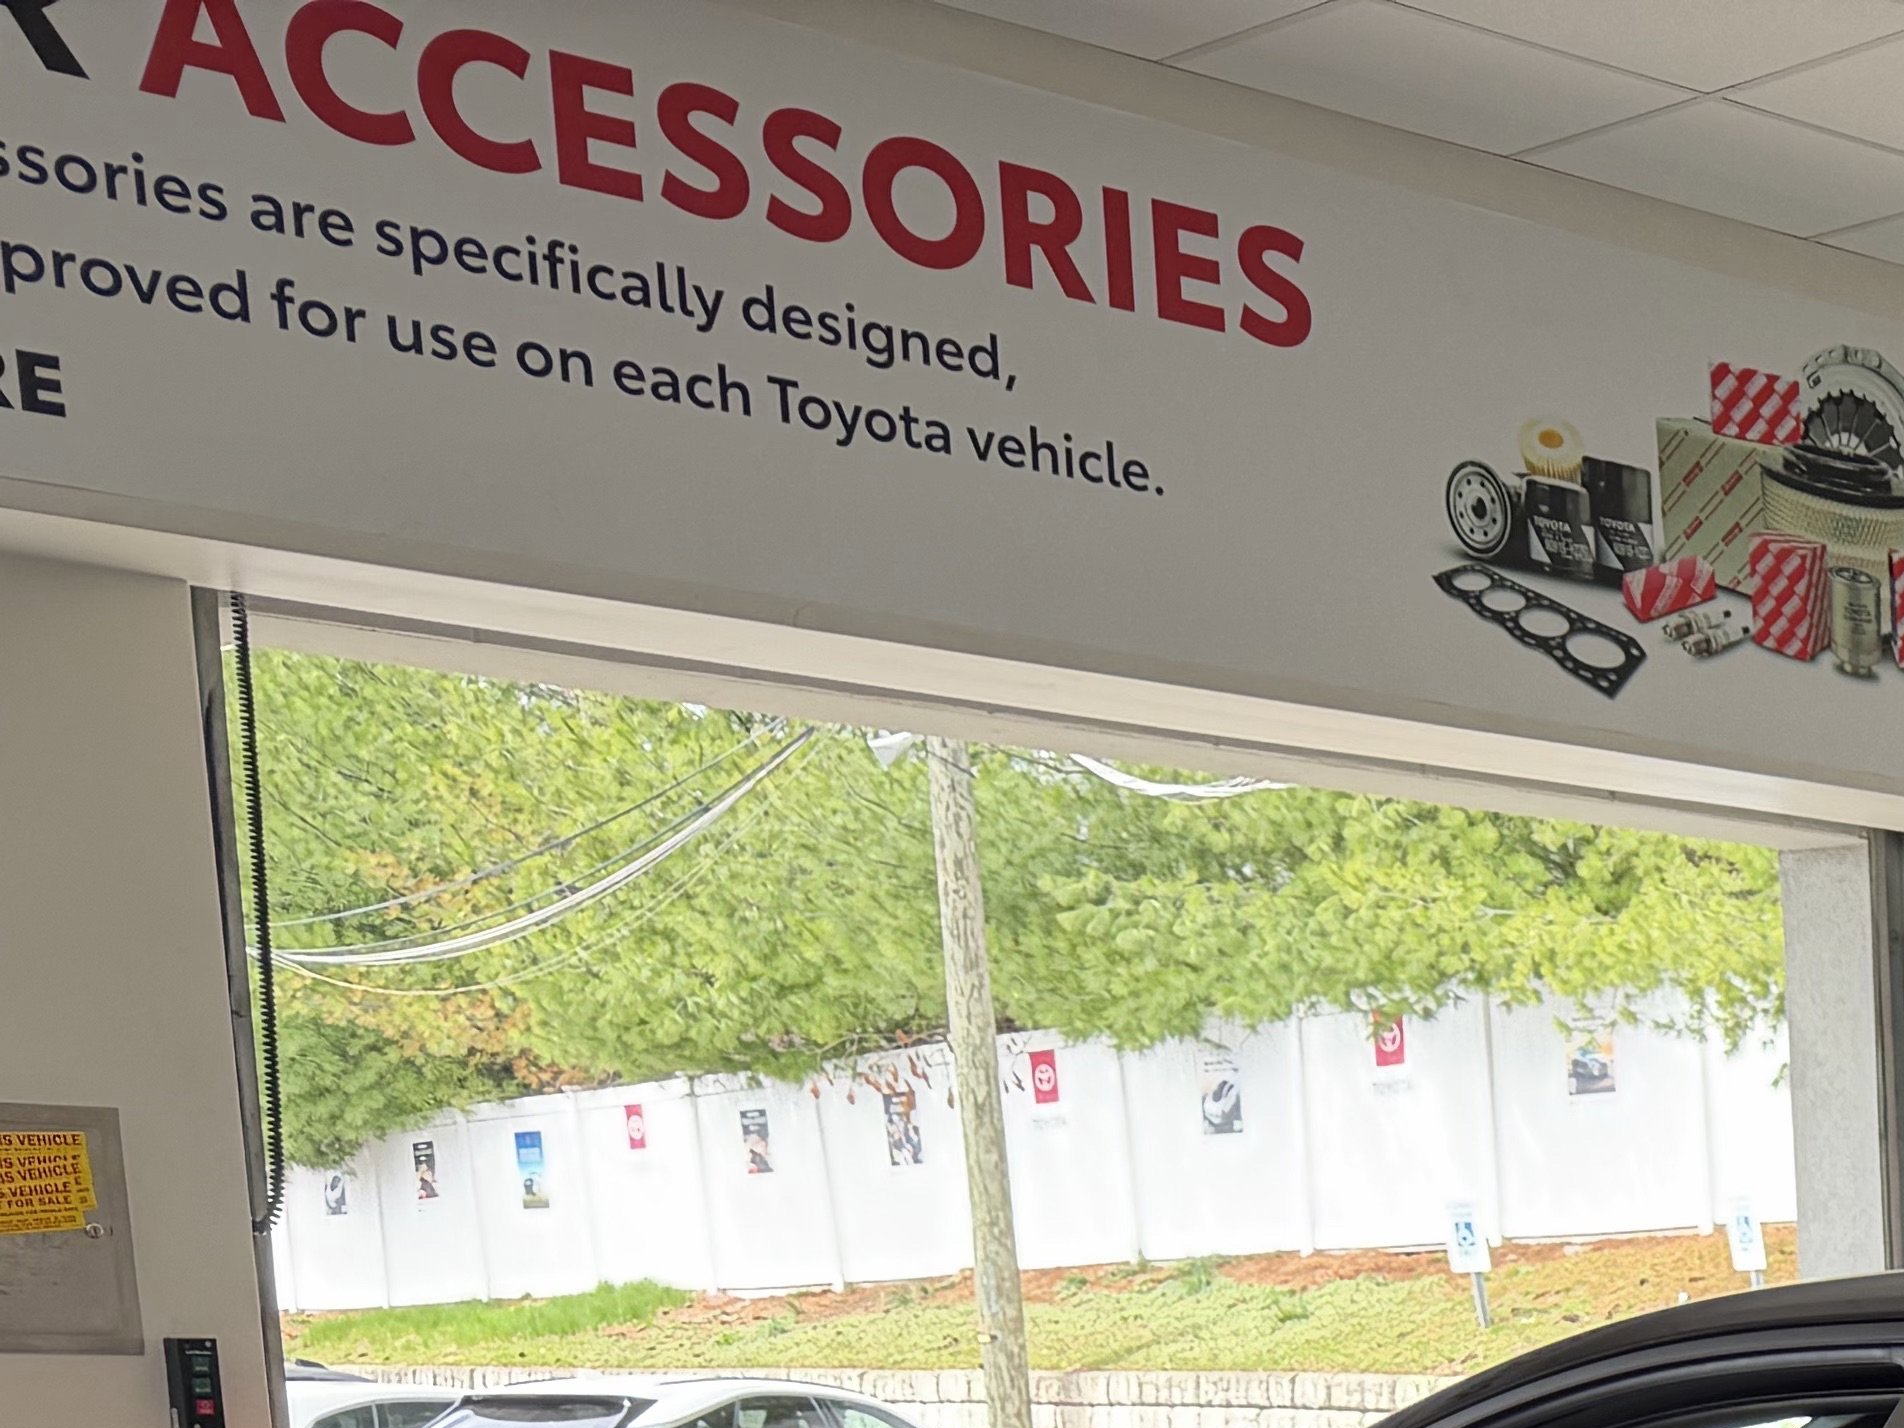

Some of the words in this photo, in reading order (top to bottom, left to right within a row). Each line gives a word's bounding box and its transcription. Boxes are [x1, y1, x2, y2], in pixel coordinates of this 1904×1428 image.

[141, 0, 1311, 347] ACCESSORIES
[250, 194, 355, 247] are
[375, 219, 726, 333] specifically
[741, 284, 1018, 392] designed,
[0, 240, 251, 324] proved
[269, 277, 368, 344] for
[386, 314, 498, 369] use
[516, 341, 594, 388] on
[613, 360, 753, 418] each
[766, 375, 953, 455] Toyota
[966, 425, 1165, 498] vehicle.
[1532, 514, 1572, 533] TOYOTA
[1599, 516, 1636, 533] TOYOTA
[16, 1133, 82, 1146] VEHICLE
[17, 1163, 82, 1181] VEHICLE
[9, 1181, 73, 1198] VEHICLE
[7, 1199, 34, 1209] FOR
[38, 1195, 73, 1206] SALE
